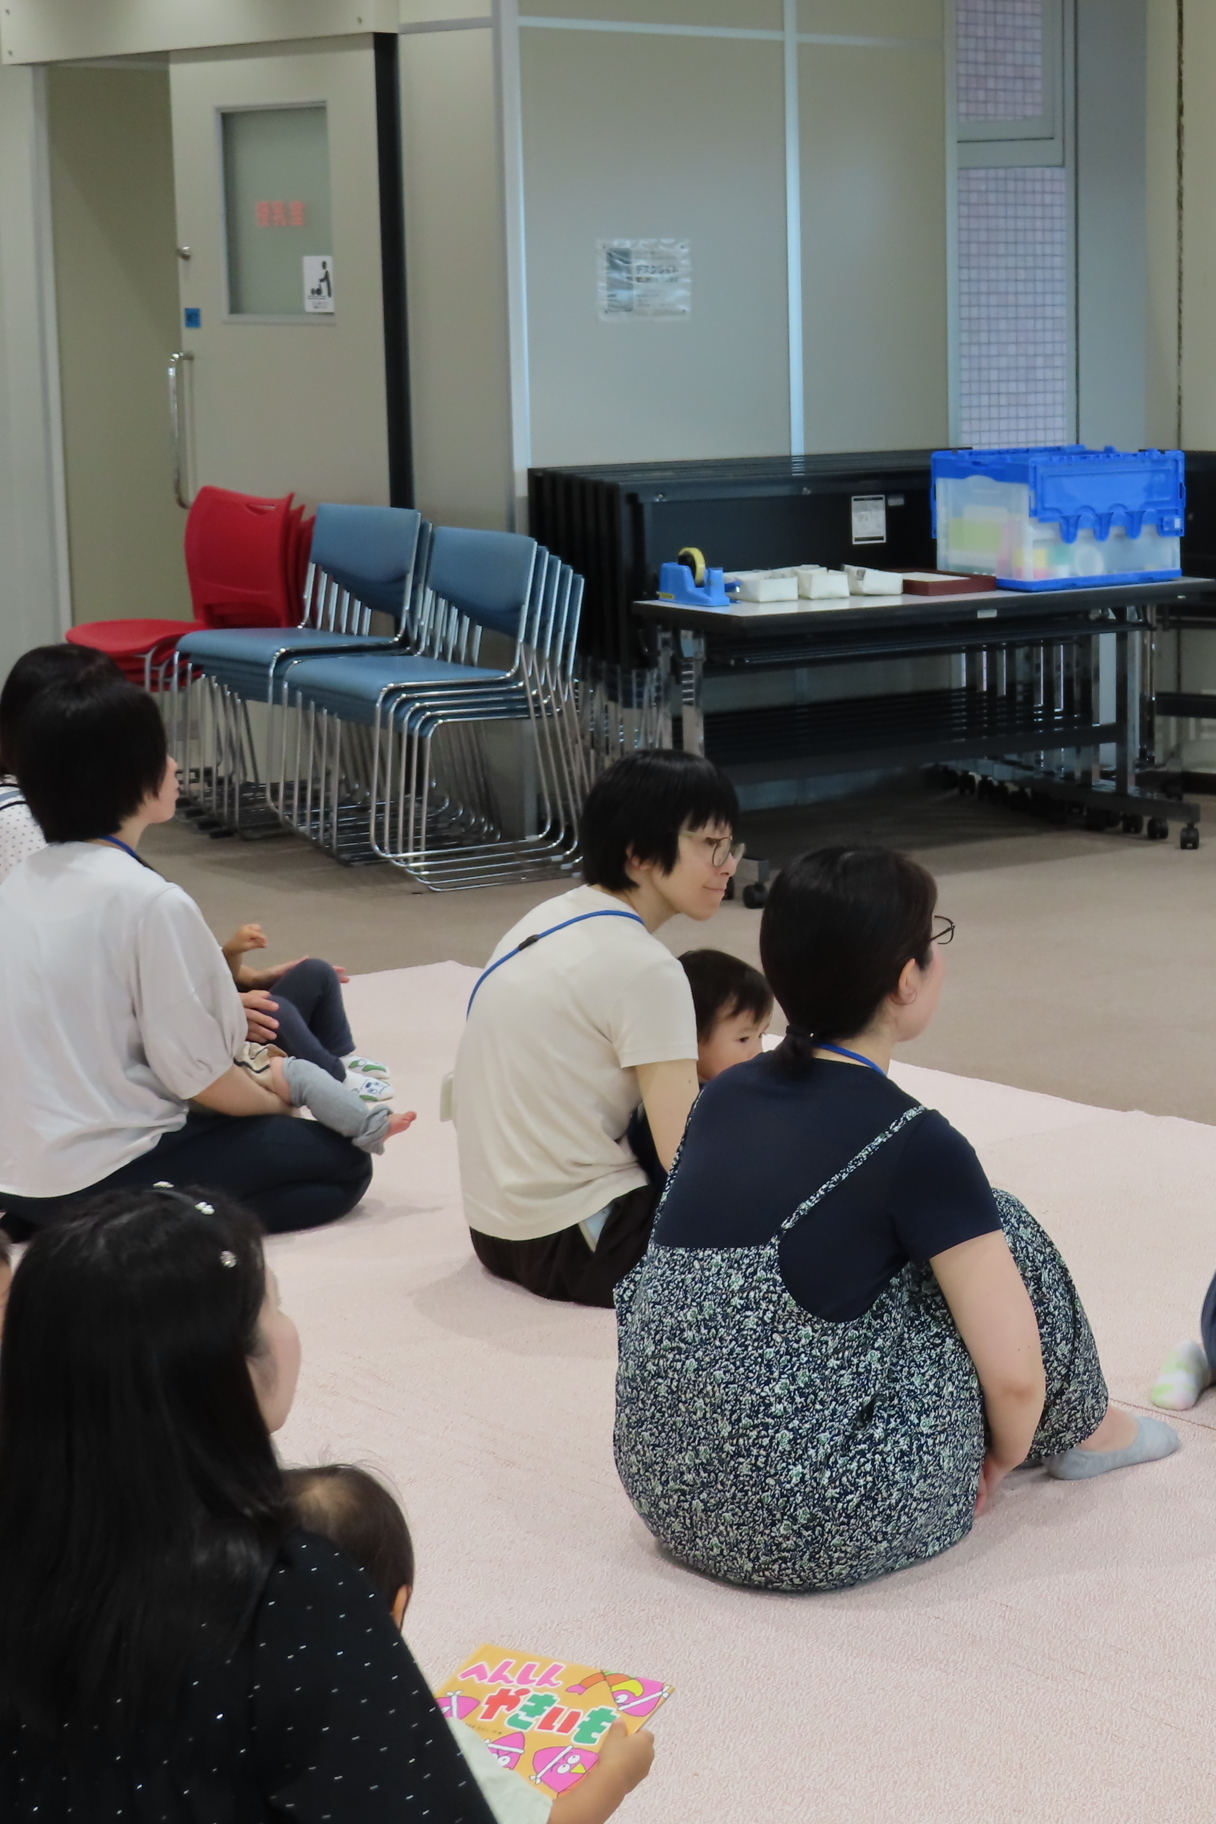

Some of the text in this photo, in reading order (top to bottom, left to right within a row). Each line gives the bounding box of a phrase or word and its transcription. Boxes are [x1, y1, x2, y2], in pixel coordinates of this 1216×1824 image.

[458, 1658, 566, 1688] へんしん
[479, 1687, 620, 1745] やきいも
